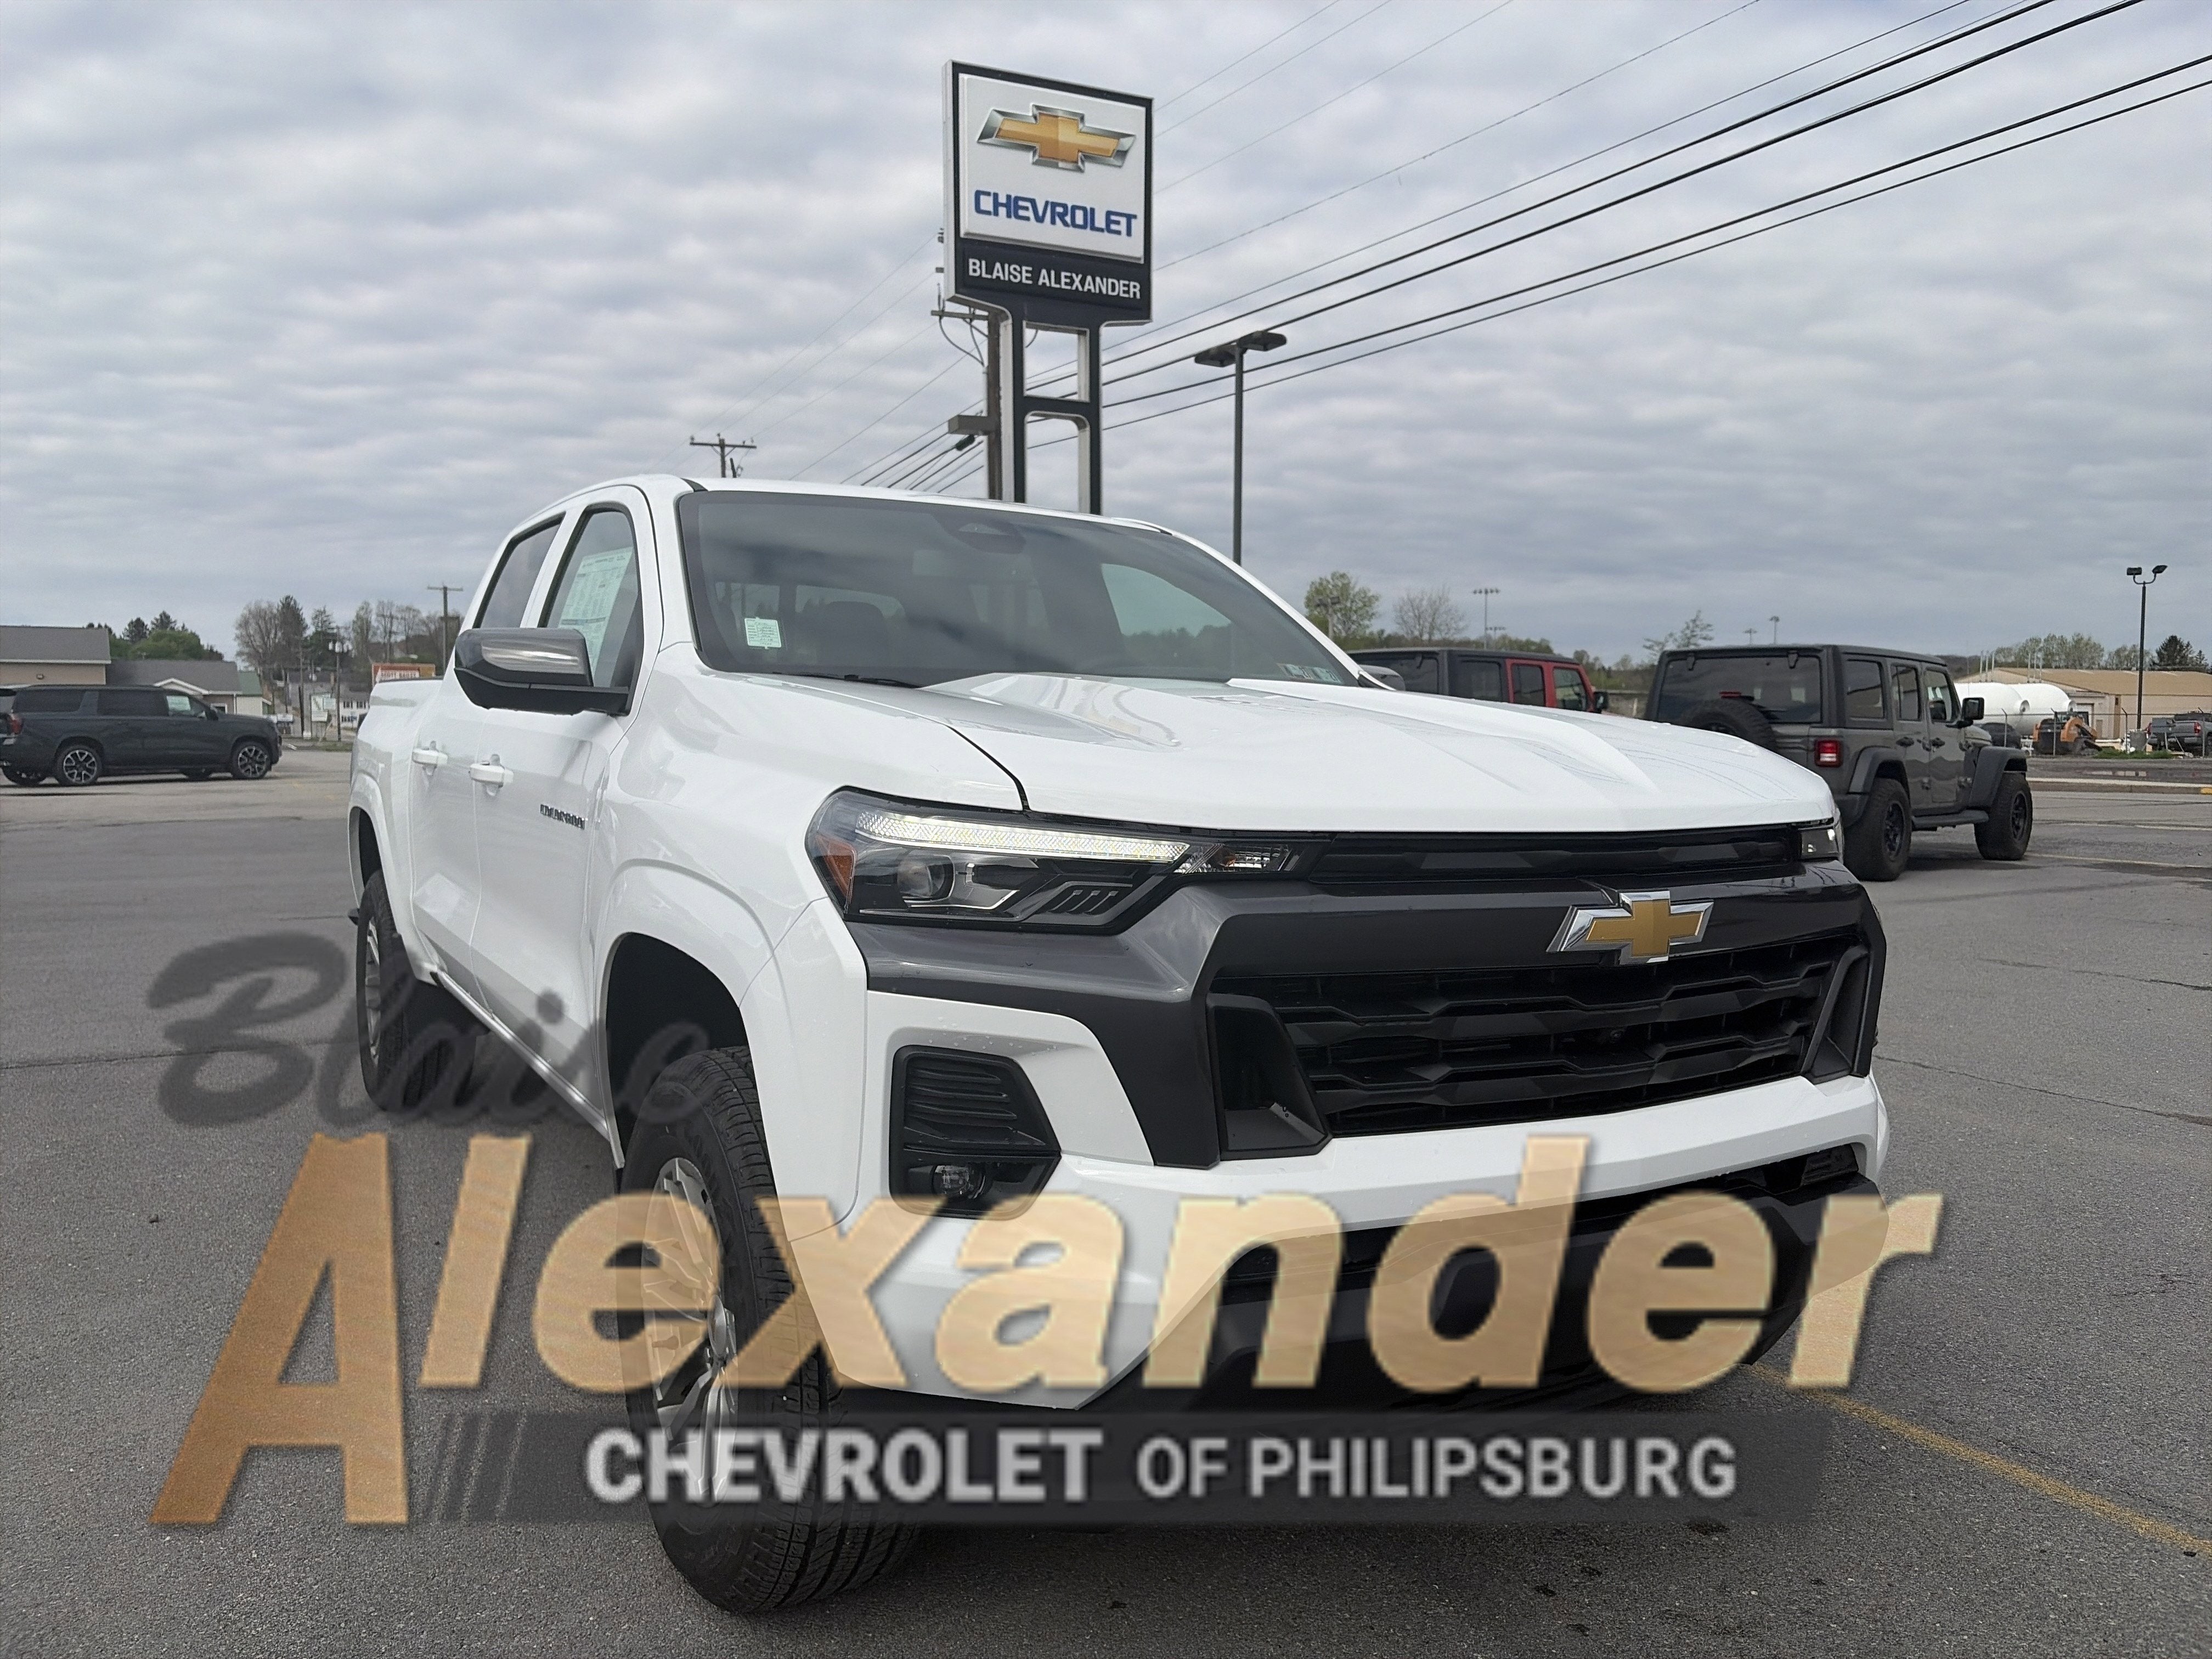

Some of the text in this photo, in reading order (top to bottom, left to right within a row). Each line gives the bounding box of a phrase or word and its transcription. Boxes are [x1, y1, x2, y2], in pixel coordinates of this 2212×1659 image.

[974, 189, 1137, 237] CHEVROLET
[968, 258, 1141, 299] BLAISE ALEXANDER
